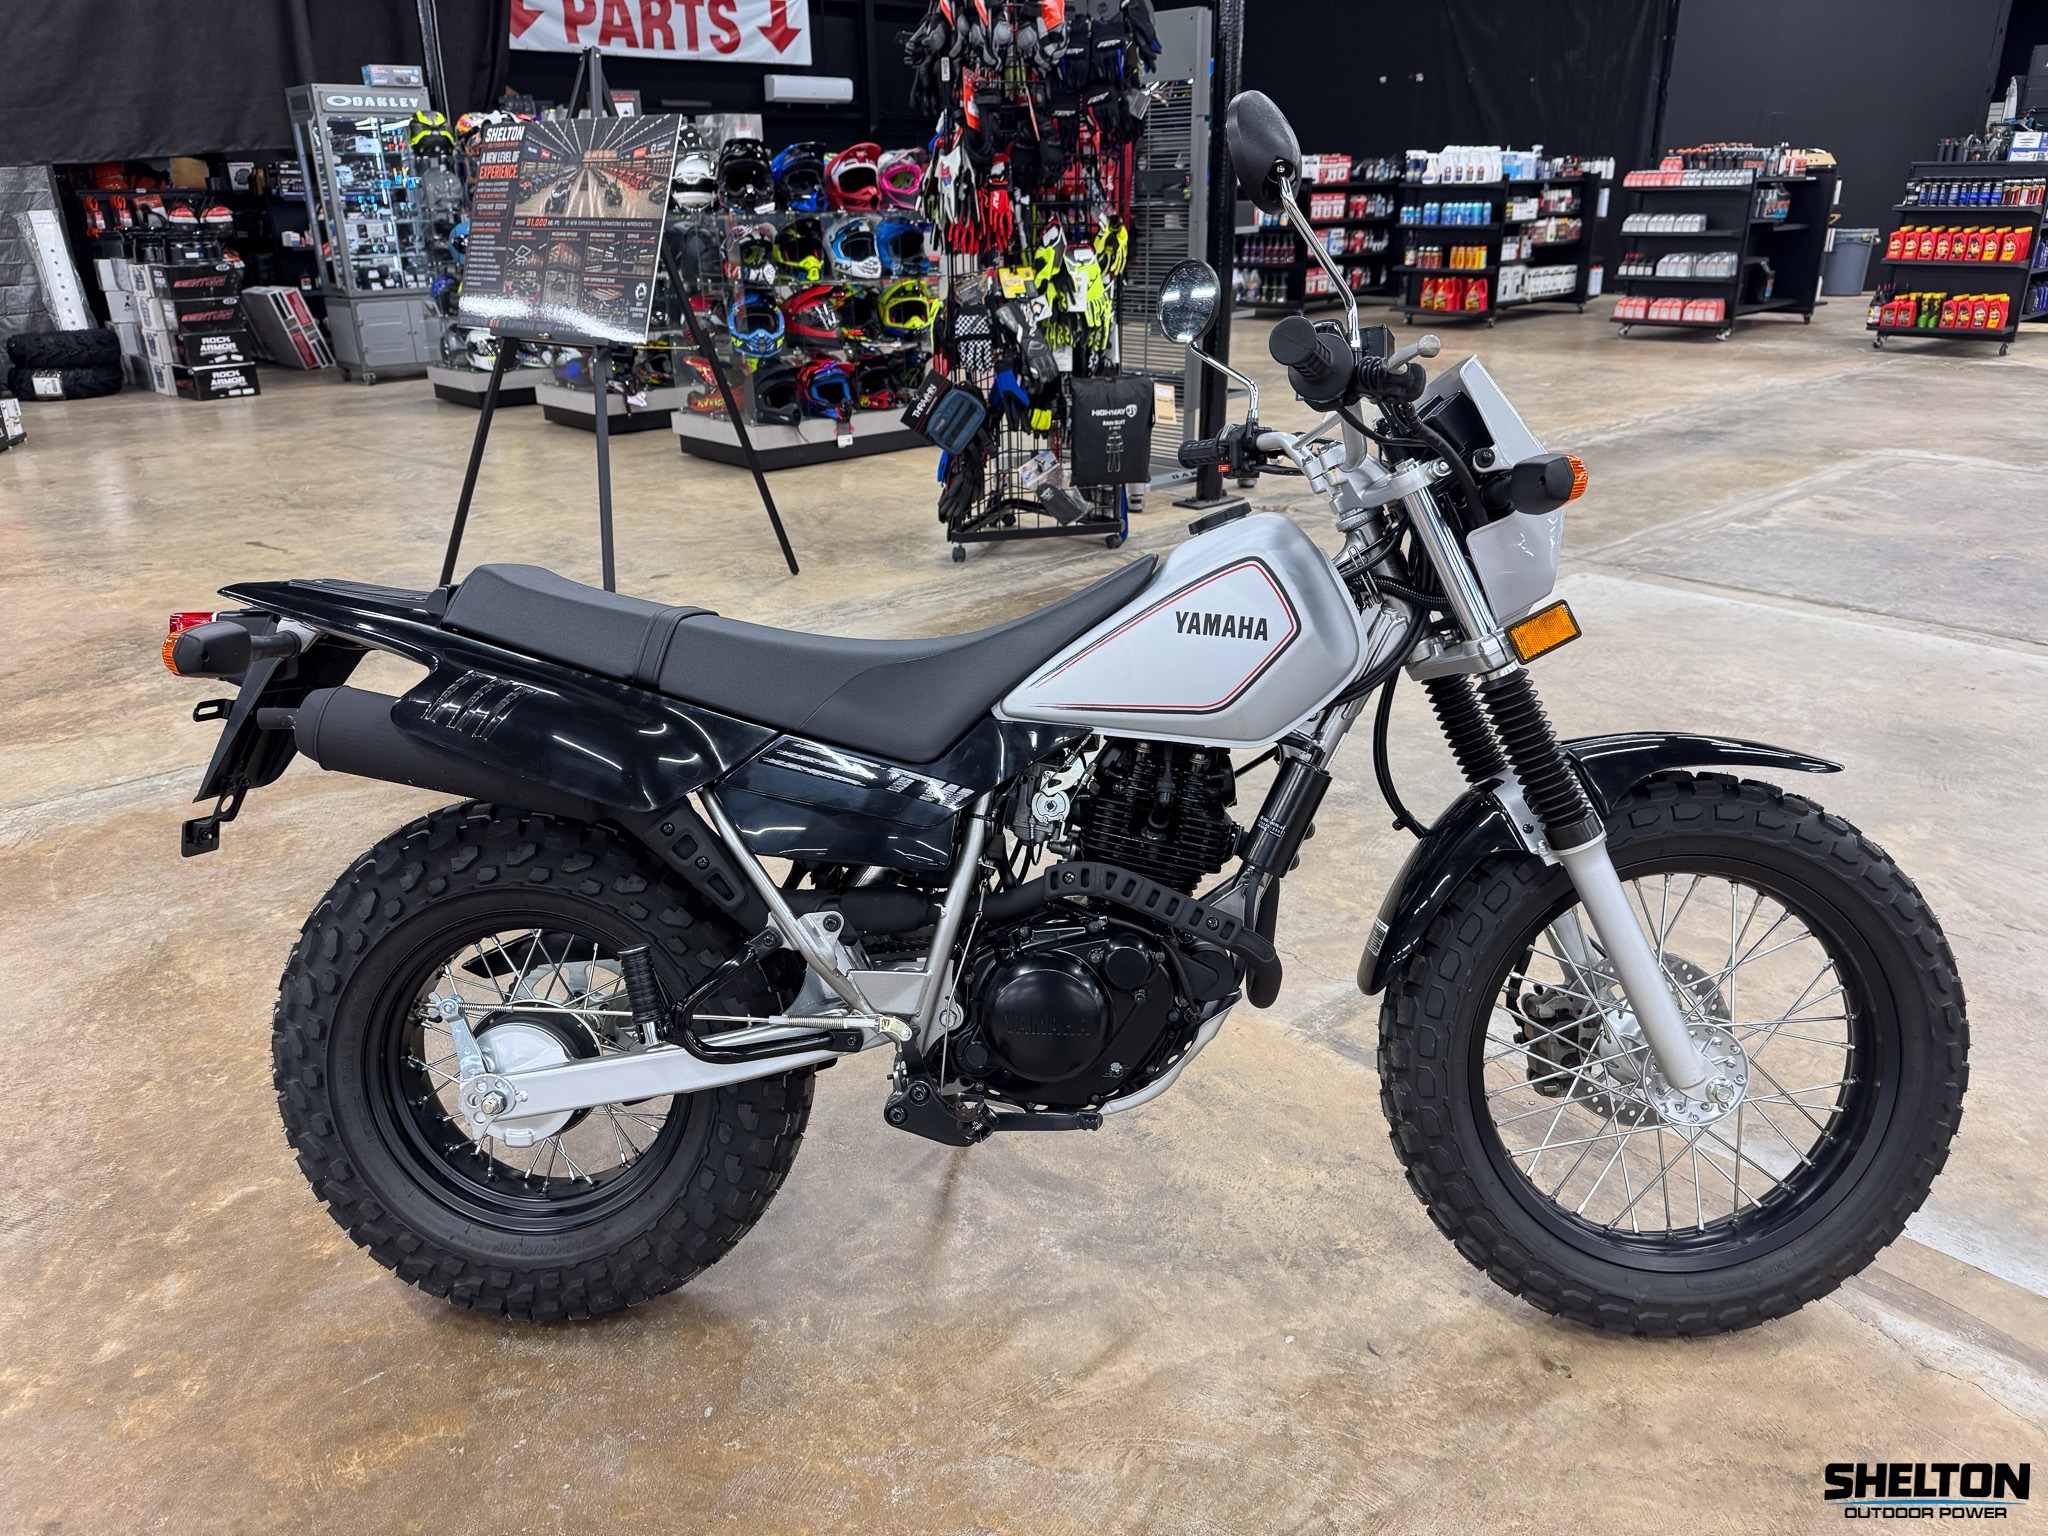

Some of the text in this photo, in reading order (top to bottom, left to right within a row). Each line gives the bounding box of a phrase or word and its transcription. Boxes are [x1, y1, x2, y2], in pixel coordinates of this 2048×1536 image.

[563, 0, 741, 54] PARTS
[352, 96, 419, 108] OAKLEY
[485, 126, 525, 142] SHELTON
[481, 150, 520, 163] A NEW LEVEL OF
[479, 164, 518, 179] EXPERIENCE.
[526, 218, 547, 226] 91,000
[834, 262, 852, 271] FLY
[489, 319, 500, 327] BIG
[202, 336, 232, 344] ROCK
[200, 342, 236, 352] ARMOR
[212, 370, 240, 378] ROCK
[211, 376, 246, 387] ARMOR
[1092, 408, 1126, 416] HIGHWAY
[1176, 611, 1268, 641] YAMAHA
[1004, 1014, 1090, 1036] YAMAHA
